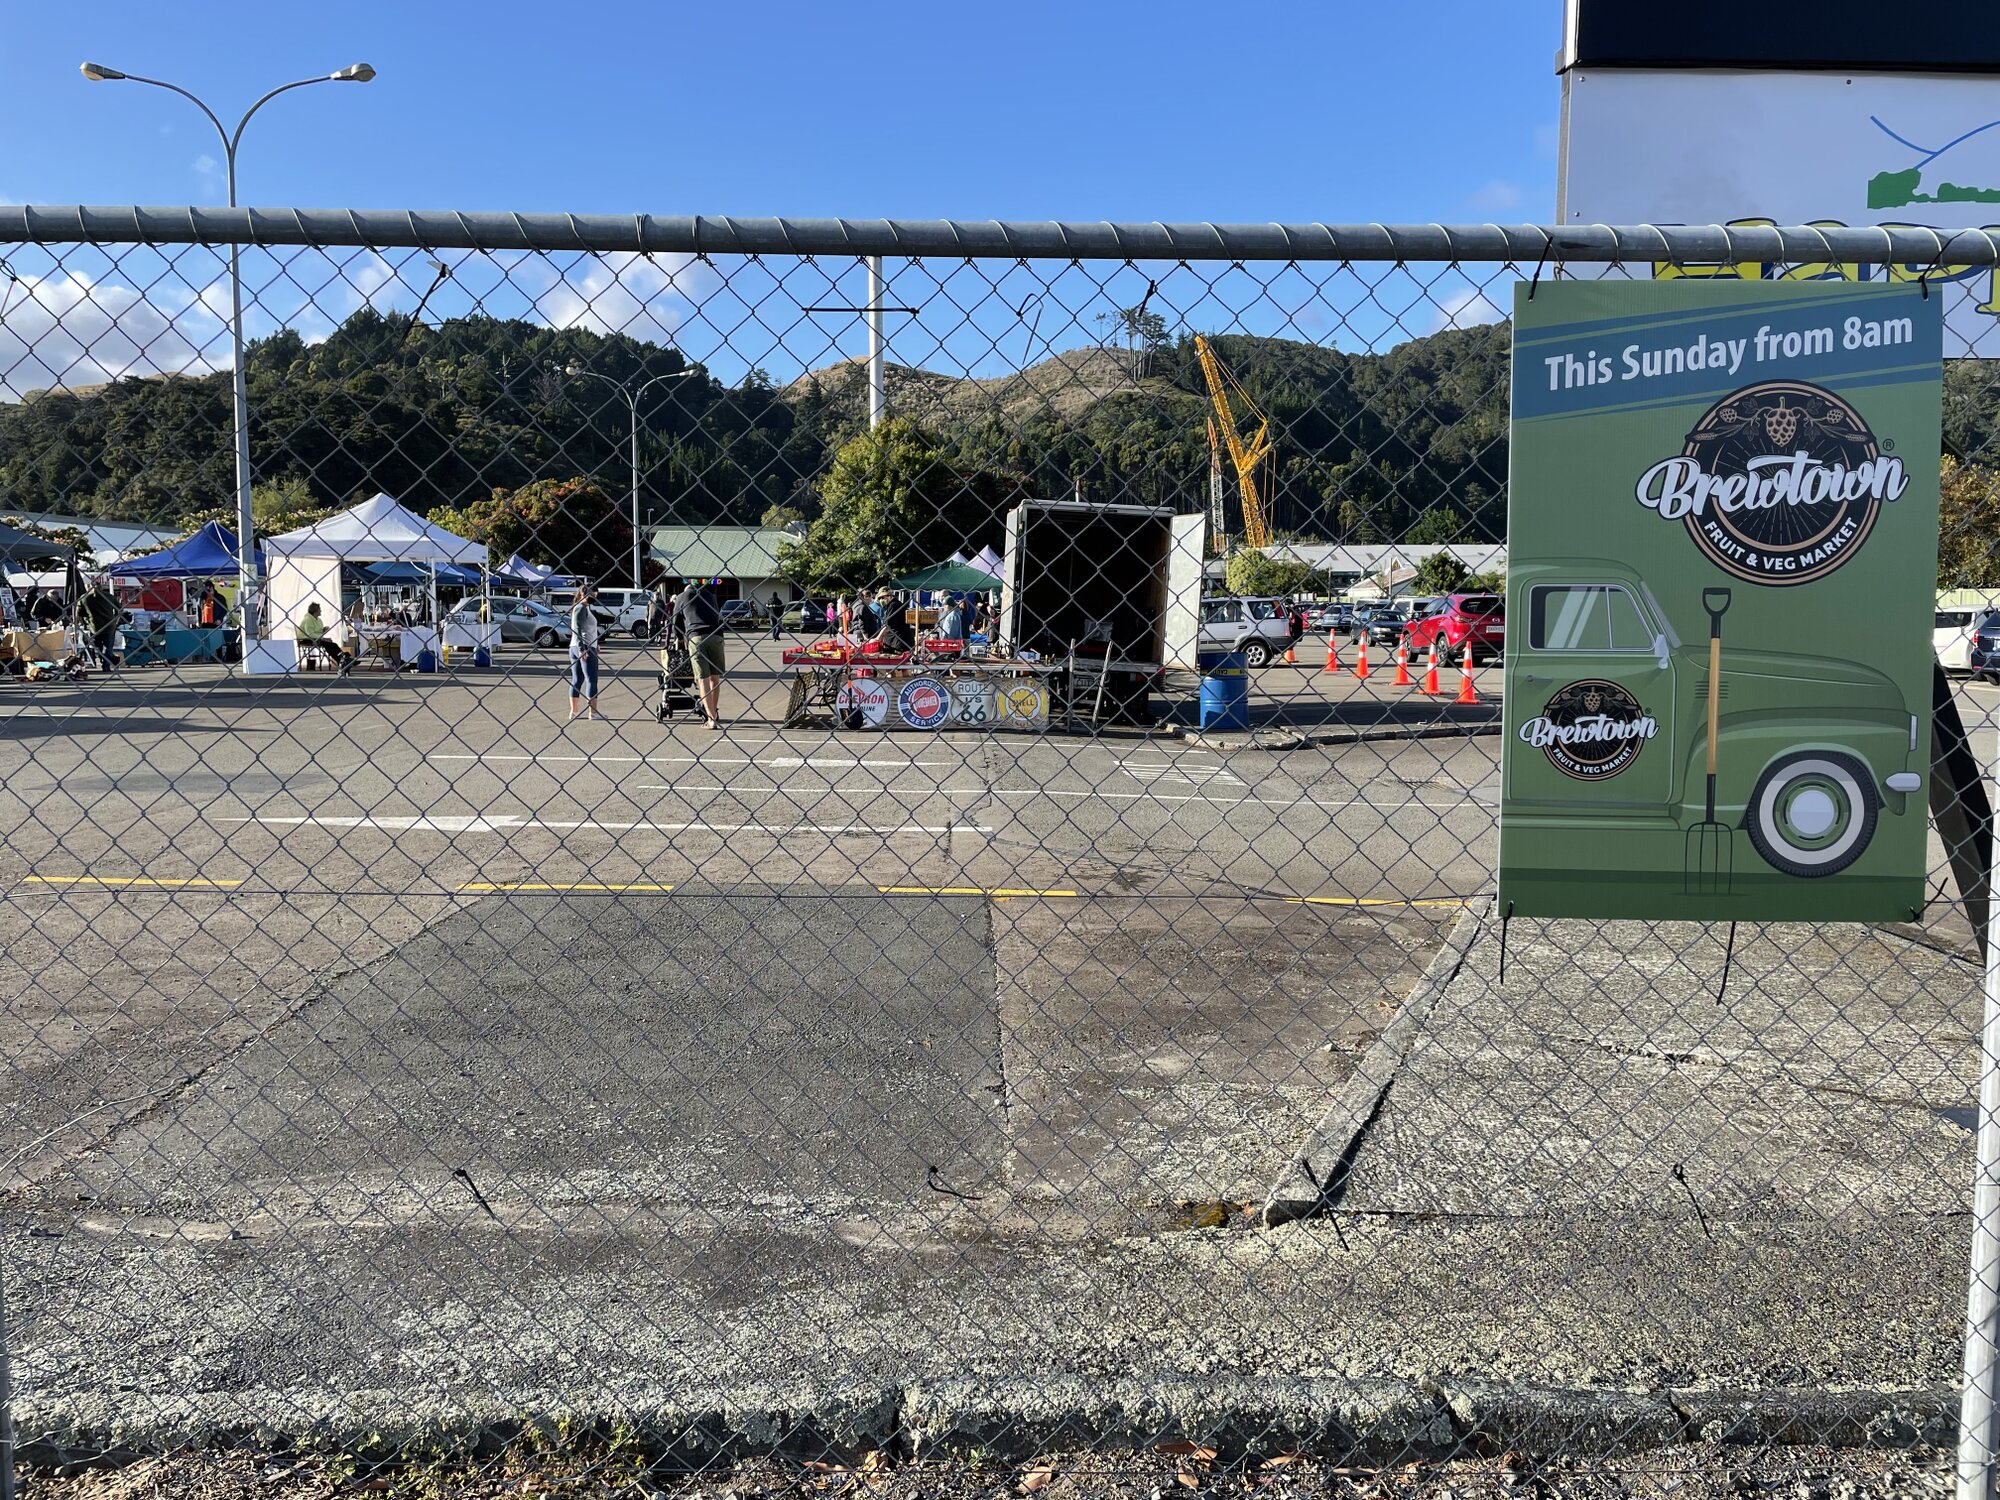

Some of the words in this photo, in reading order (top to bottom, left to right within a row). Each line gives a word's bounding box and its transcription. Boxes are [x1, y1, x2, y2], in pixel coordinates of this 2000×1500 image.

[1545, 350, 1613, 391] This
[1621, 334, 1747, 376] Sunday
[1754, 325, 1834, 362] from
[1843, 316, 1913, 350] 8am
[1637, 450, 1909, 519] Brewtown
[1704, 520, 1746, 560] FRUIT
[1746, 553, 1758, 567] &
[1763, 556, 1796, 570] VEG
[1800, 517, 1858, 568] MARKET
[958, 684, 989, 693] ROUTE
[910, 712, 944, 726] SERVICE
[960, 704, 987, 722] 66
[1519, 713, 1659, 748] Brewtown
[1552, 748, 1574, 768] FRUIT
[1583, 766, 1601, 774] VEG
[1602, 747, 1632, 772] MARKET
